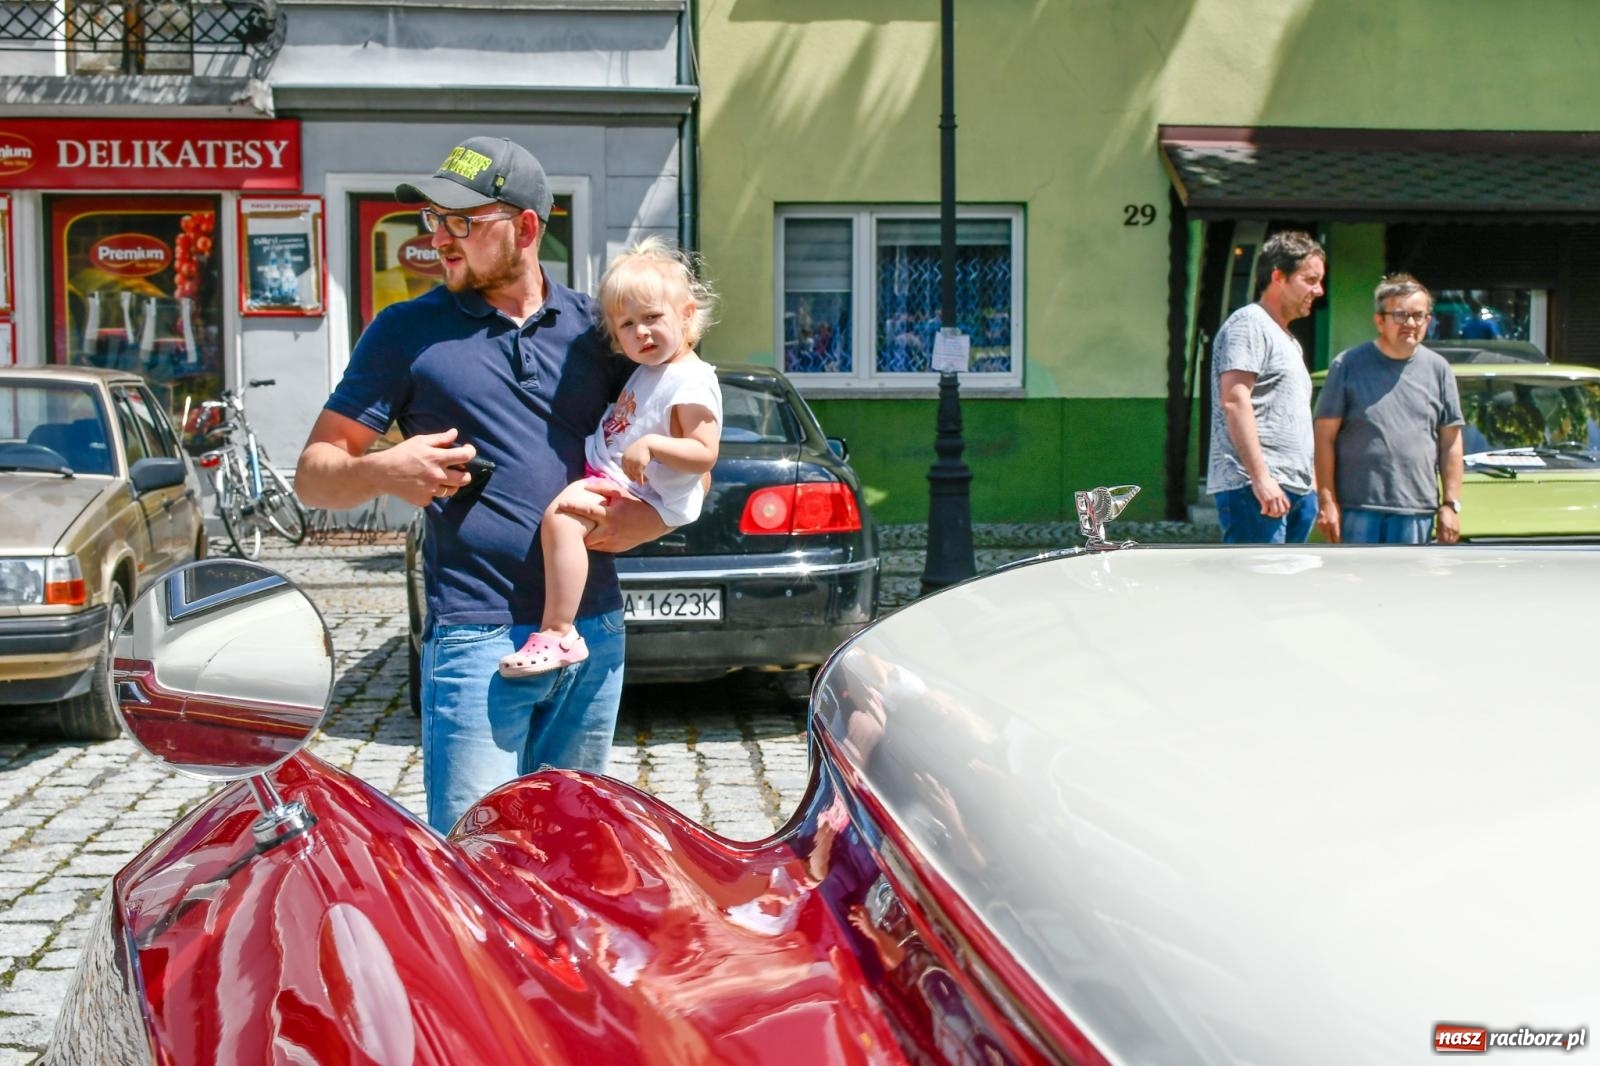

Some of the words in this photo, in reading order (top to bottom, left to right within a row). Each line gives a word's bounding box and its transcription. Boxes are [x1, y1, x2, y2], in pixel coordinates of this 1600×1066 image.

[56, 140, 289, 168] DELIKATESY
[1123, 203, 1157, 226] 29
[98, 246, 165, 260] Premium
[623, 593, 636, 616] A
[647, 592, 716, 616] 1623K
